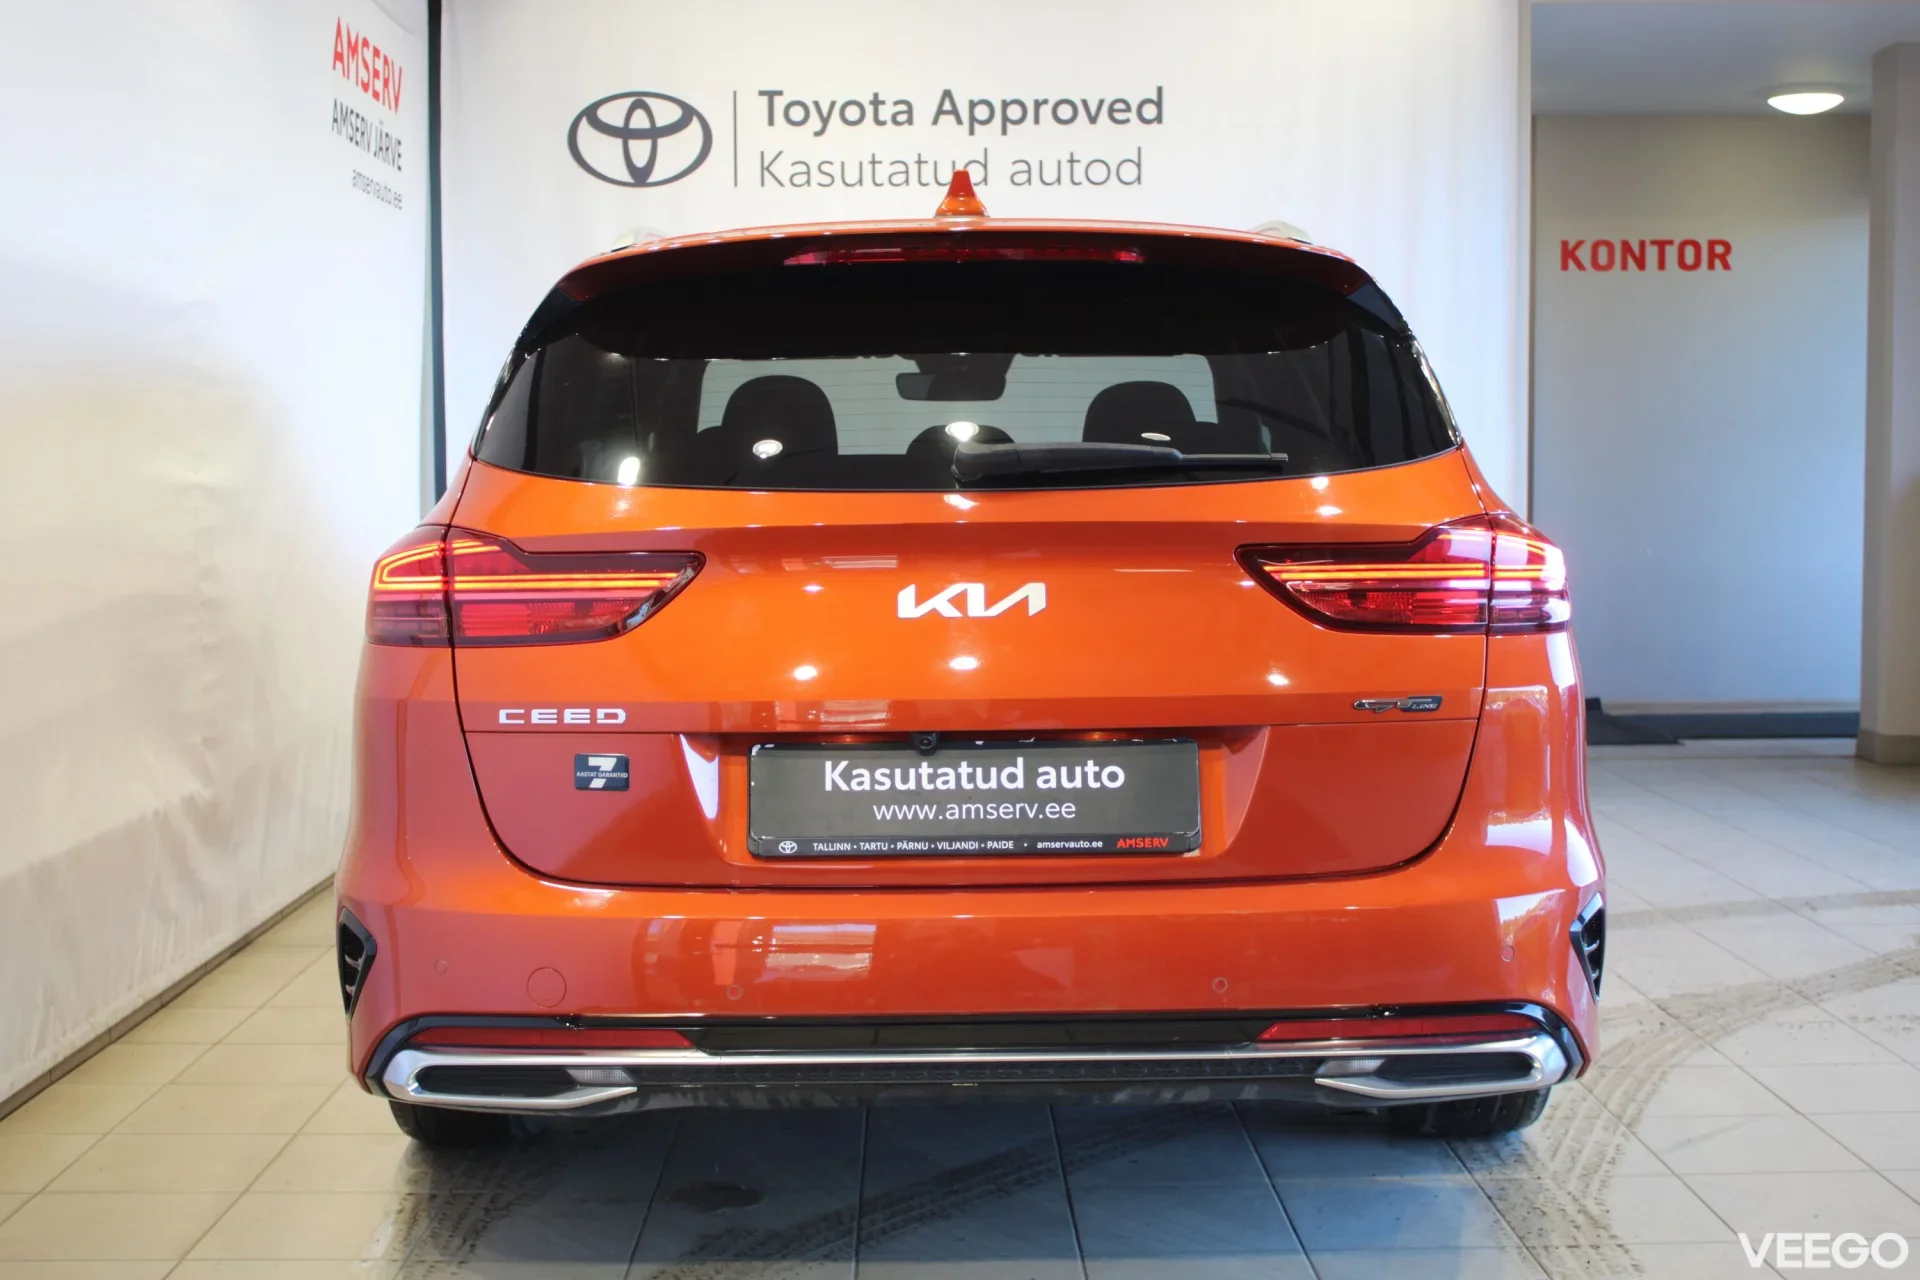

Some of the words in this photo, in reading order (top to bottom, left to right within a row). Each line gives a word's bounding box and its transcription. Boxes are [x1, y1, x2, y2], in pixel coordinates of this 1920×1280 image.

[332, 16, 402, 114] AMSERV
[758, 89, 914, 137] Toyota
[932, 86, 1164, 136] Approved
[332, 98, 373, 154] AMSERV
[373, 119, 402, 172] JÄRVE
[759, 147, 988, 188] Kasutatud
[1009, 147, 1143, 186] autod
[352, 168, 403, 210] amservauto.ee
[1560, 239, 1733, 272] KONTOR
[897, 582, 1046, 618] KIA
[499, 709, 627, 724] CEED
[588, 756, 617, 788] 7
[824, 757, 1024, 792] Kasutatud
[1036, 760, 1125, 790] auto
[873, 802, 1077, 821] www.amserv.ee
[813, 842, 851, 851] TALLINN
[859, 842, 888, 851] TARTU
[897, 840, 929, 850] PÄRNU
[937, 841, 979, 850] VILJANDI
[987, 840, 1014, 849] PAIDE
[1037, 840, 1103, 849] amservauto.ee
[1116, 837, 1169, 848] AMSERV
